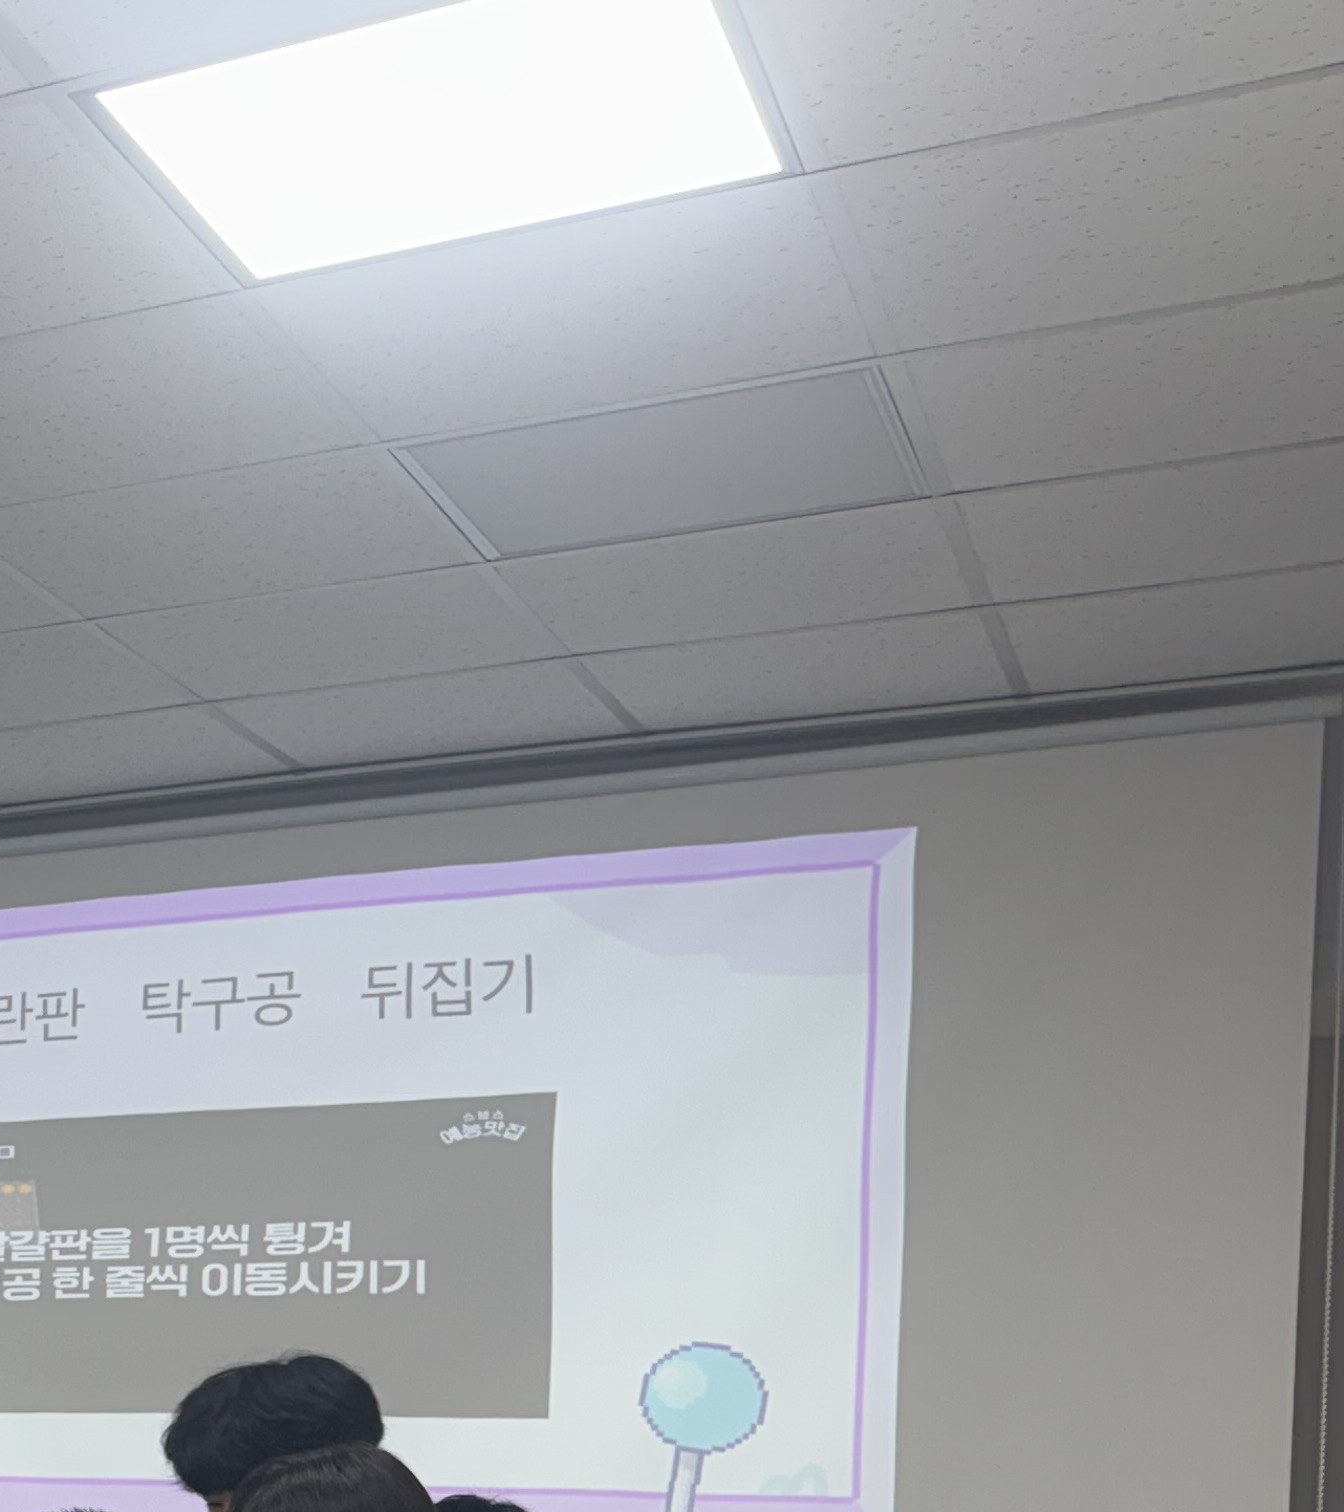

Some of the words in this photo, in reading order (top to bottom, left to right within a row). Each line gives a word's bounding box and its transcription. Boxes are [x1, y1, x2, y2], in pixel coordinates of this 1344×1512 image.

[140, 970, 303, 1035] 탁구공
[360, 953, 535, 1021] 뒤집기
[143, 1223, 250, 1260] 1명씩
[262, 1219, 352, 1257] 튕겨
[52, 1266, 94, 1300] 한
[105, 1264, 189, 1299] 줄씩
[200, 1260, 426, 1297] 이동시키기
